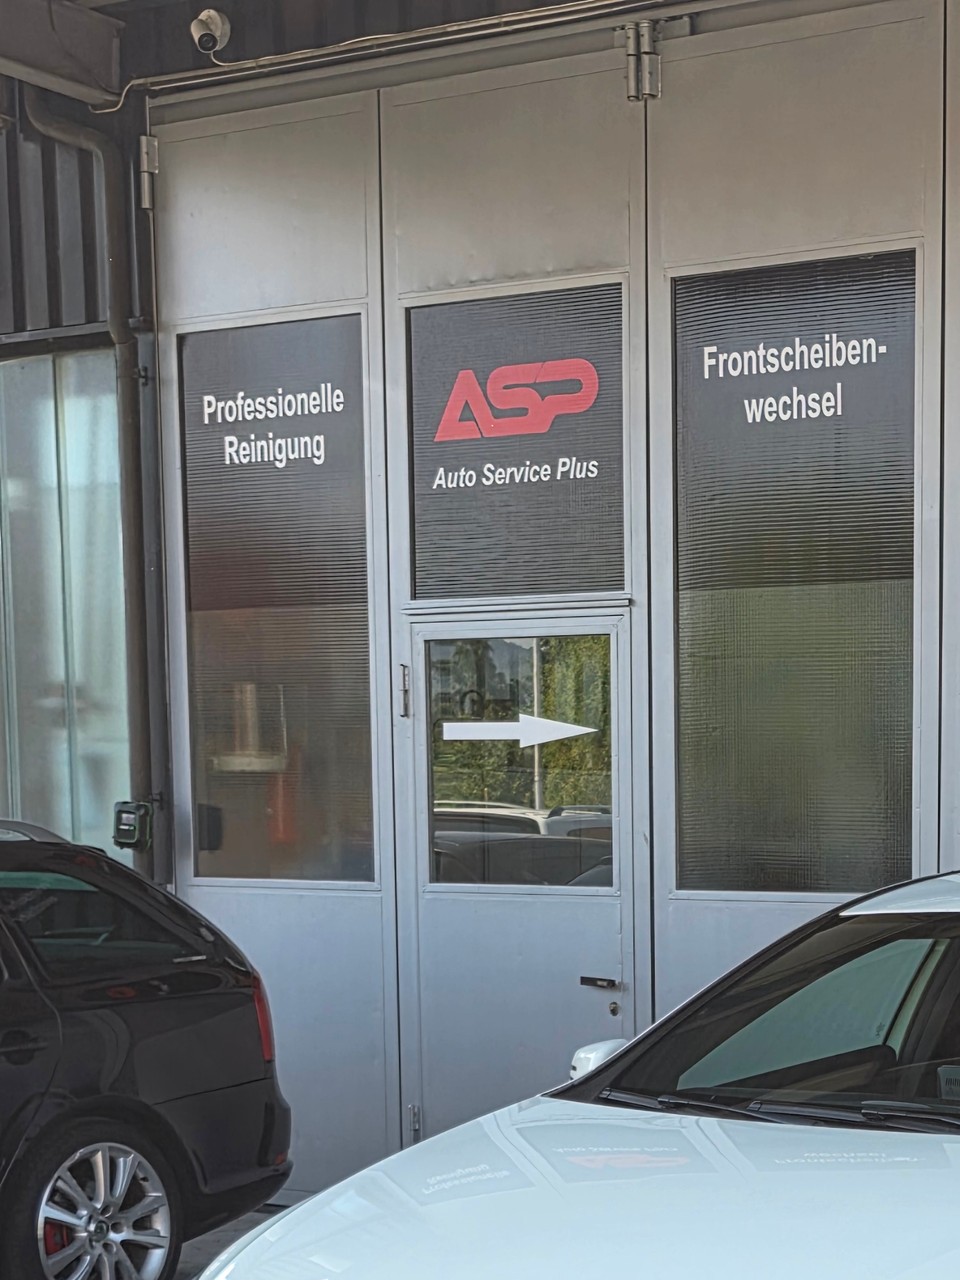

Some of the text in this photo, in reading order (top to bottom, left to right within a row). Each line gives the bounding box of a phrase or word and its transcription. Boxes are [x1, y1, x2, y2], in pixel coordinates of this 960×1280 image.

[702, 332, 888, 380] Frontscheiben-
[202, 382, 345, 425] Professionelle
[433, 357, 600, 443] ASP
[743, 383, 844, 424] wechsel
[223, 431, 326, 469] Reinigung
[432, 456, 600, 491] Auto Service Plus
